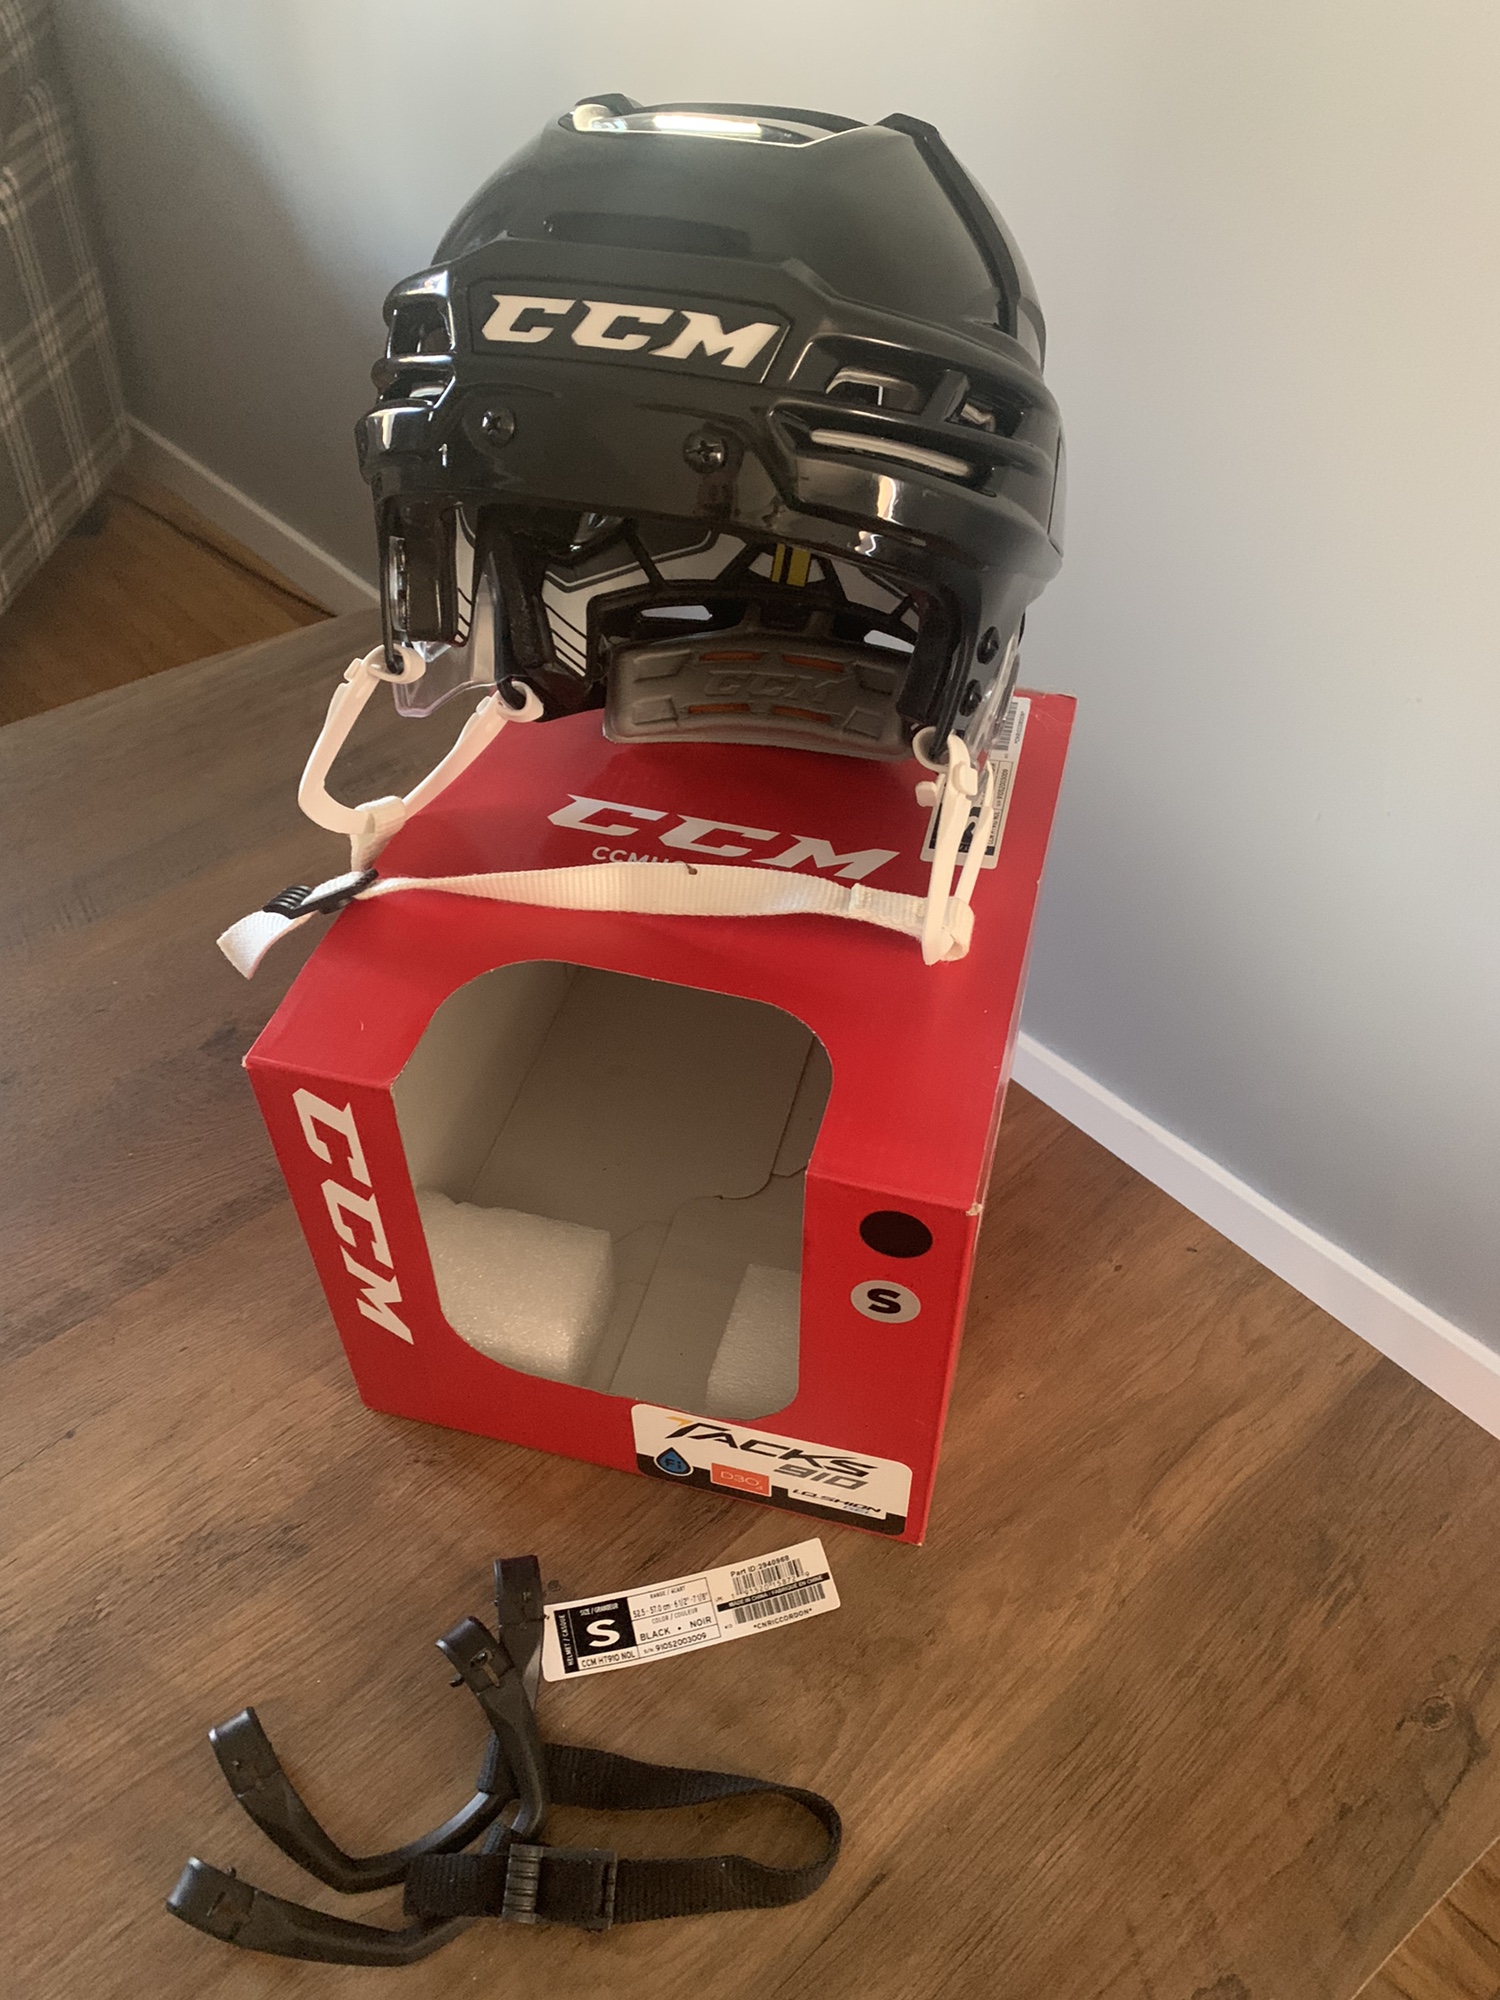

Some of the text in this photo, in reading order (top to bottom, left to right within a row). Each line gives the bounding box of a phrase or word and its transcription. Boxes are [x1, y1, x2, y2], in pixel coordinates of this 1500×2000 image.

[481, 294, 782, 369] CCM
[547, 794, 901, 880] CCM
[292, 1088, 414, 1345] CCM
[867, 1288, 901, 1314] S
[665, 1416, 878, 1478] TACKS
[774, 1463, 868, 1490] 910
[730, 1569, 746, 1577] Part
[586, 1619, 620, 1647] S
[640, 1627, 670, 1641] BLACK
[690, 1617, 711, 1627] NOIR
[581, 1657, 596, 1668] CCM
